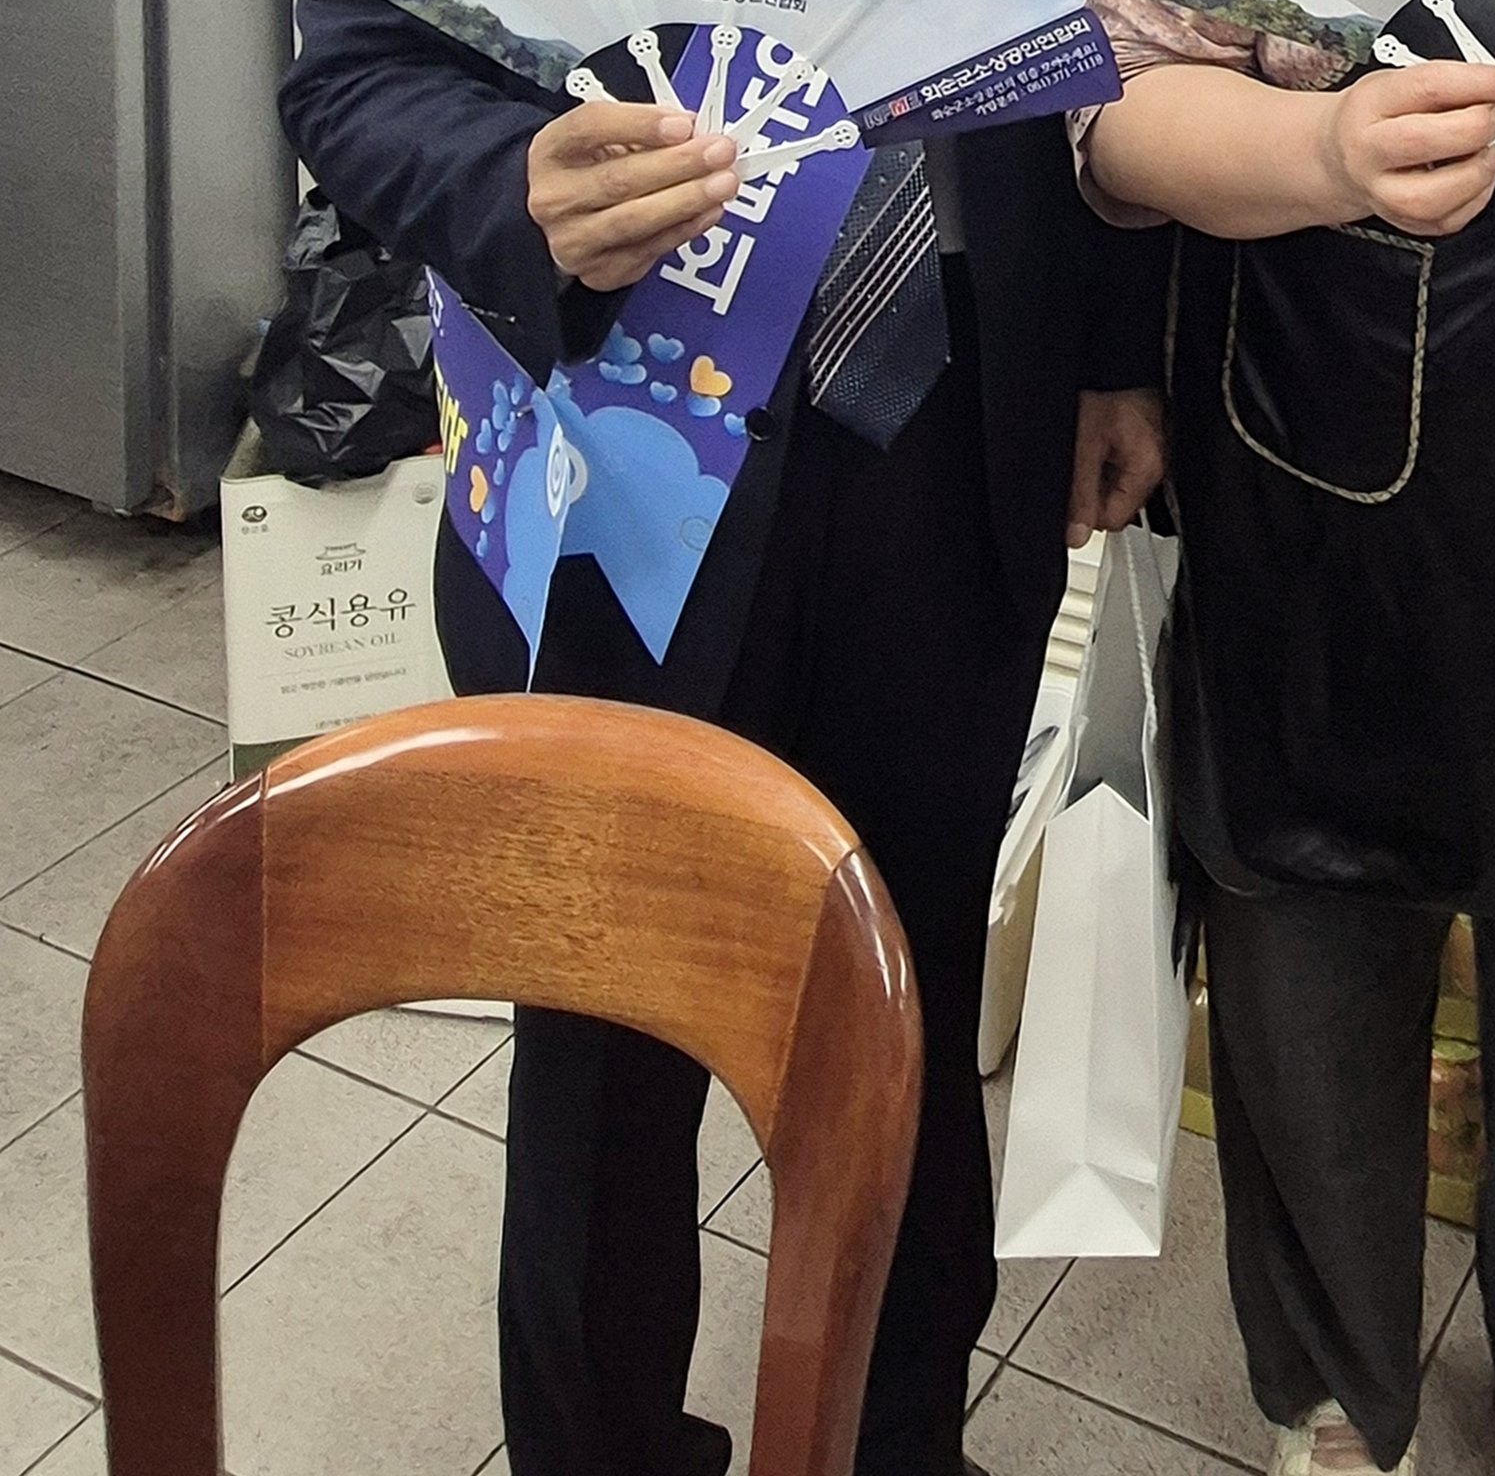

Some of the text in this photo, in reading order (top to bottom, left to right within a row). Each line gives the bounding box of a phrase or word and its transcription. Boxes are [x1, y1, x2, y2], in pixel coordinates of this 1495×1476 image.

[919, 16, 1093, 103] 화순군소상공인연합회
[265, 587, 416, 639] 콩식용유
[283, 632, 401, 661] SOYBEAN OIL
